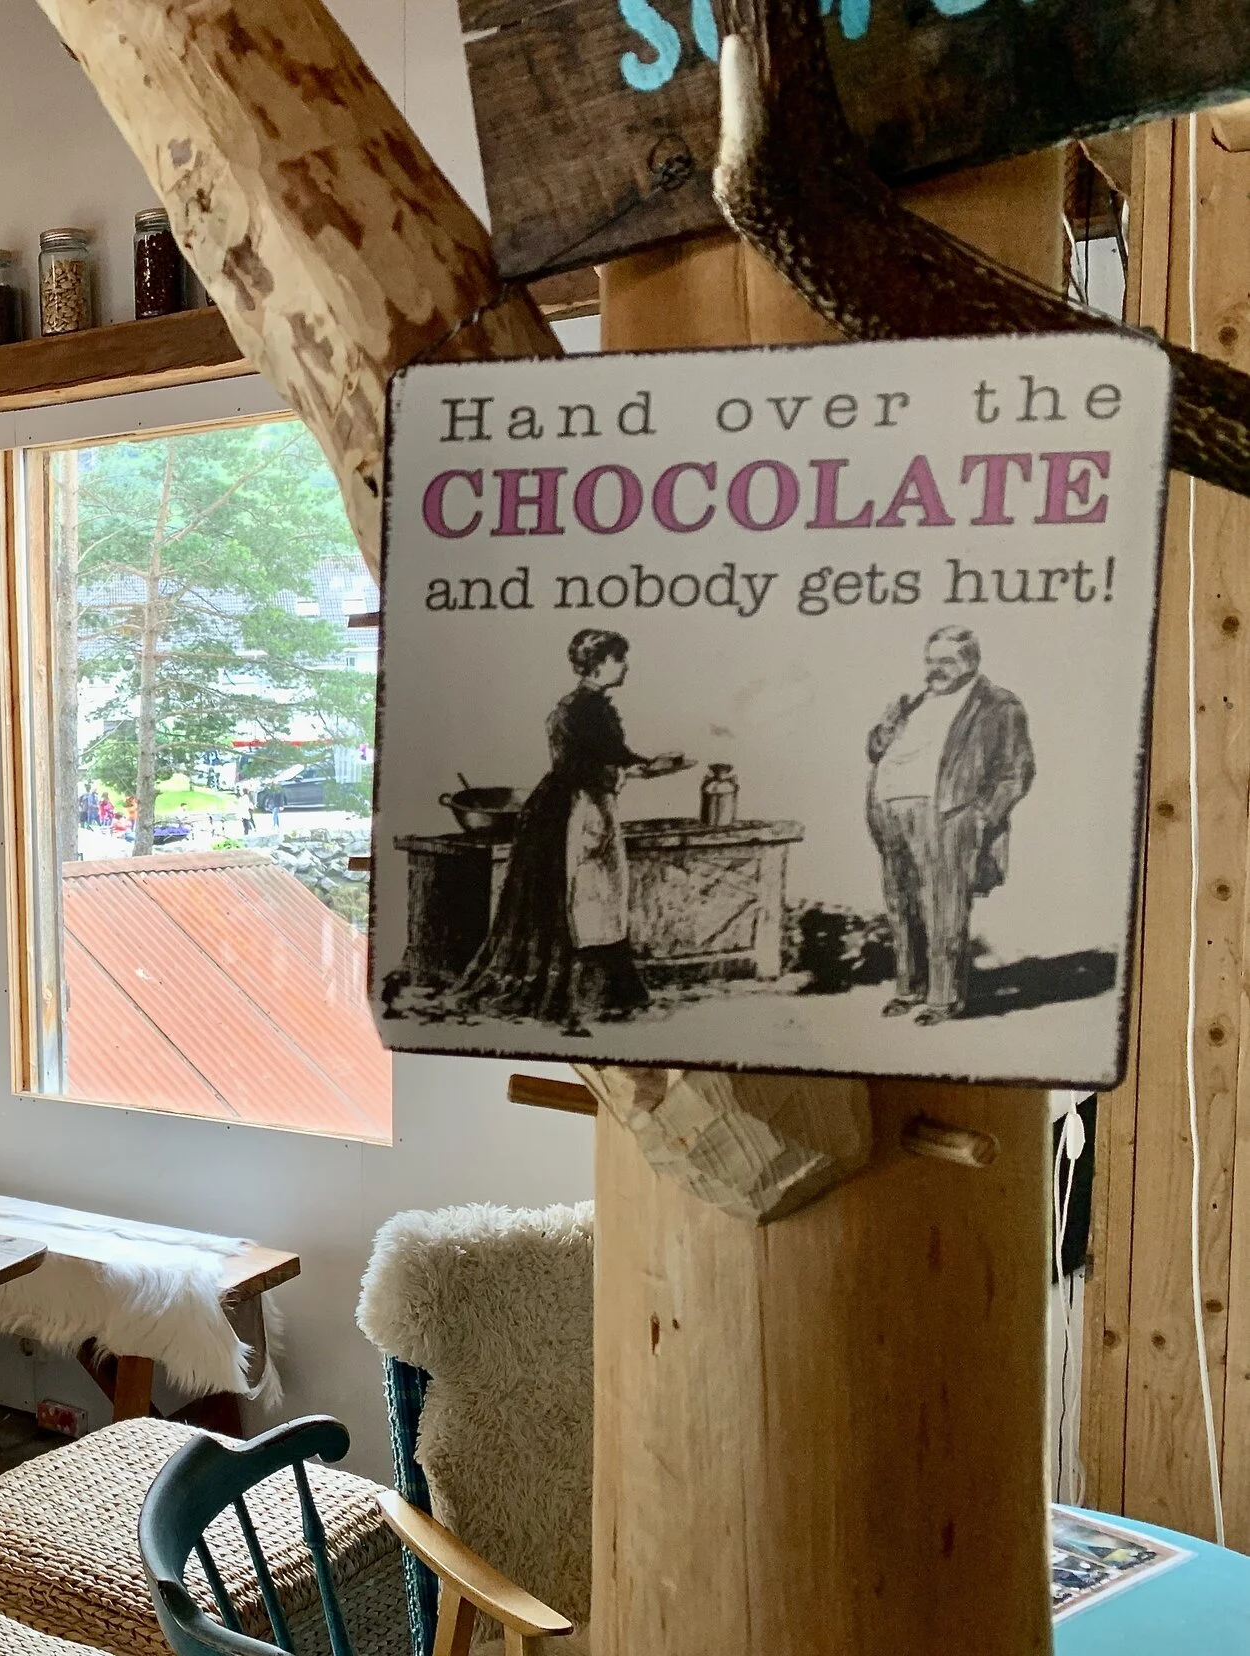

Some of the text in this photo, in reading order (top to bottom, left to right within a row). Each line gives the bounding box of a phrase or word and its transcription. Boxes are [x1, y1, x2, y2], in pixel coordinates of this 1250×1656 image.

[439, 374, 1123, 442] Hand over the
[422, 450, 1111, 538] CHOCOLATE
[425, 555, 1115, 617] and nobody gets hurt!
